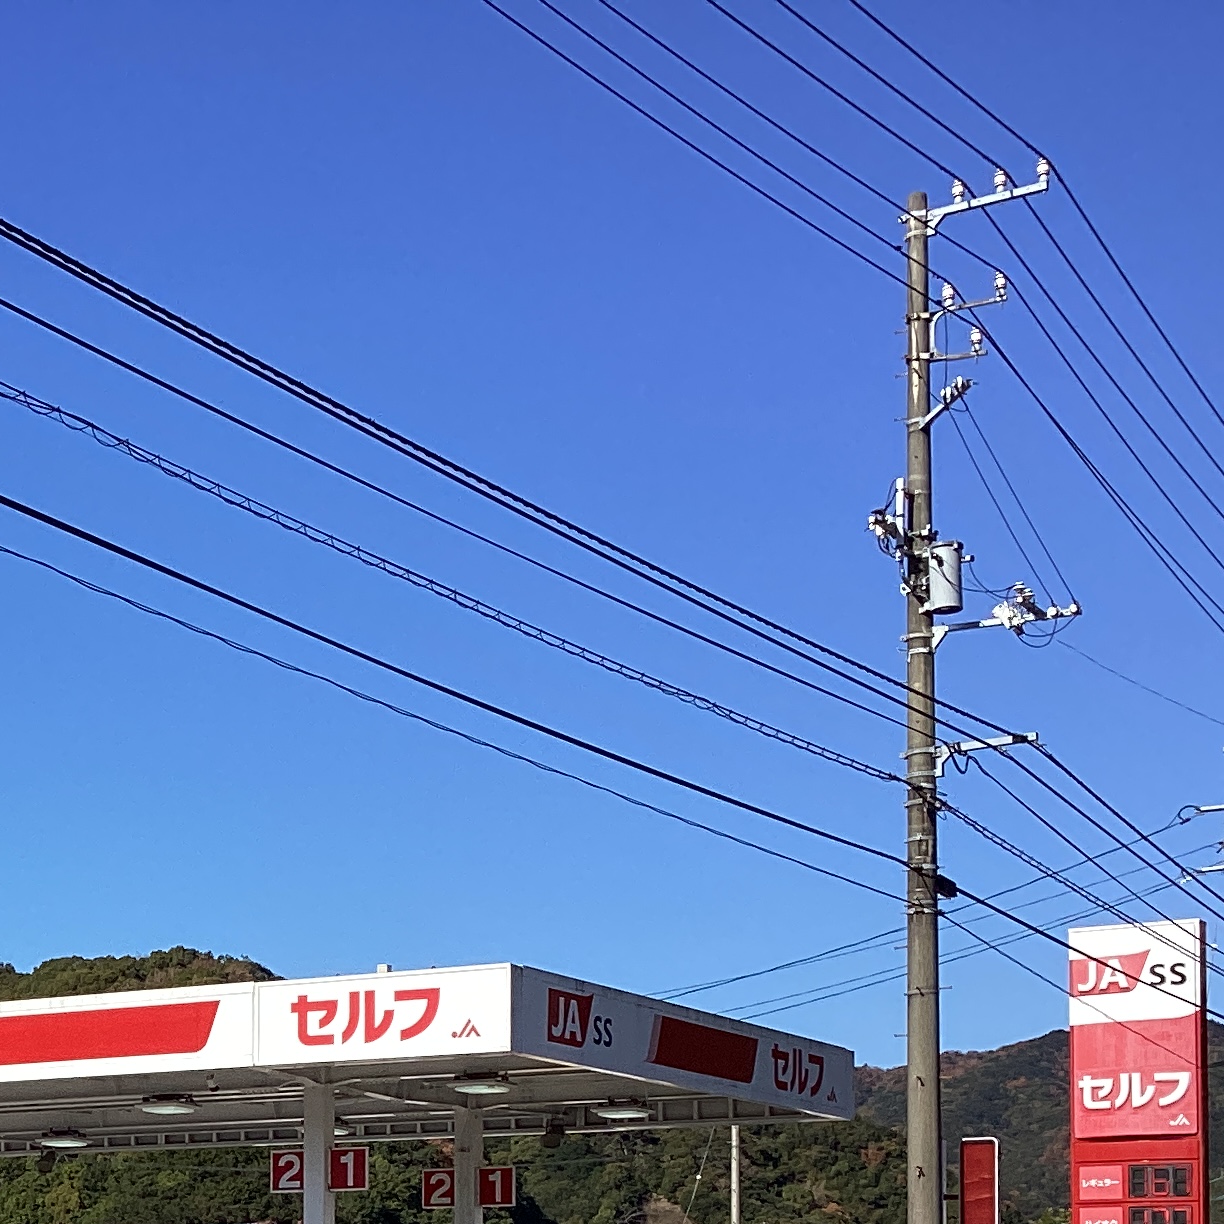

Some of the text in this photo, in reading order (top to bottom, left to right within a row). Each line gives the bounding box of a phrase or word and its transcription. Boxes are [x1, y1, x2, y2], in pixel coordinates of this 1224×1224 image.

[1078, 959, 1187, 992] JA SS
[291, 988, 440, 1046] セルフ
[552, 996, 613, 1047] JA SS
[771, 1043, 824, 1097] セルフ
[1078, 1071, 1191, 1110] セルフ
[278, 1151, 354, 1189] 2 1
[429, 1170, 502, 1205] 2 1
